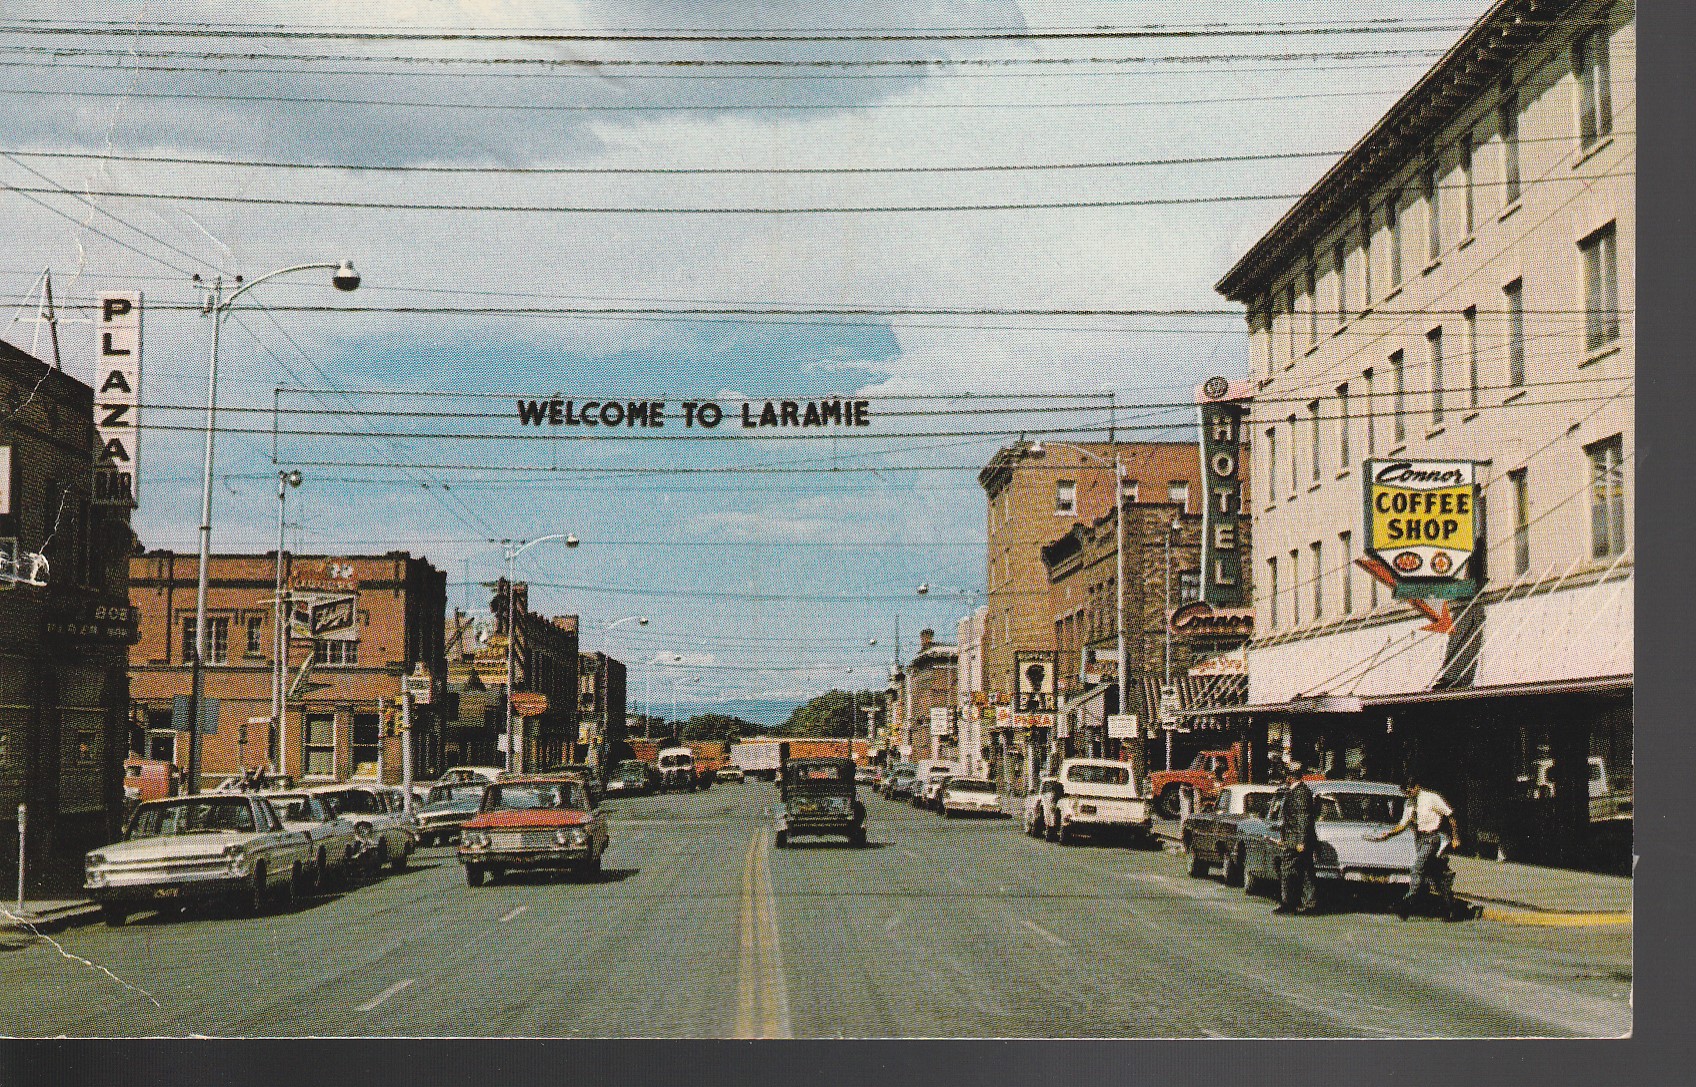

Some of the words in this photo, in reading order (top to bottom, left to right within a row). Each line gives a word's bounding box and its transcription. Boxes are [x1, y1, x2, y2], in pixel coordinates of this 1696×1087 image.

[101, 298, 132, 462] PLAZA
[517, 400, 665, 428] WELCOME
[682, 402, 722, 428] TO
[742, 400, 870, 428] LARAMIE
[1374, 462, 1463, 483] Connor
[1212, 415, 1235, 585] HOTEL
[1375, 492, 1471, 514] COFFEE
[1387, 518, 1458, 541] SHOP
[1171, 601, 1254, 629] Connor
